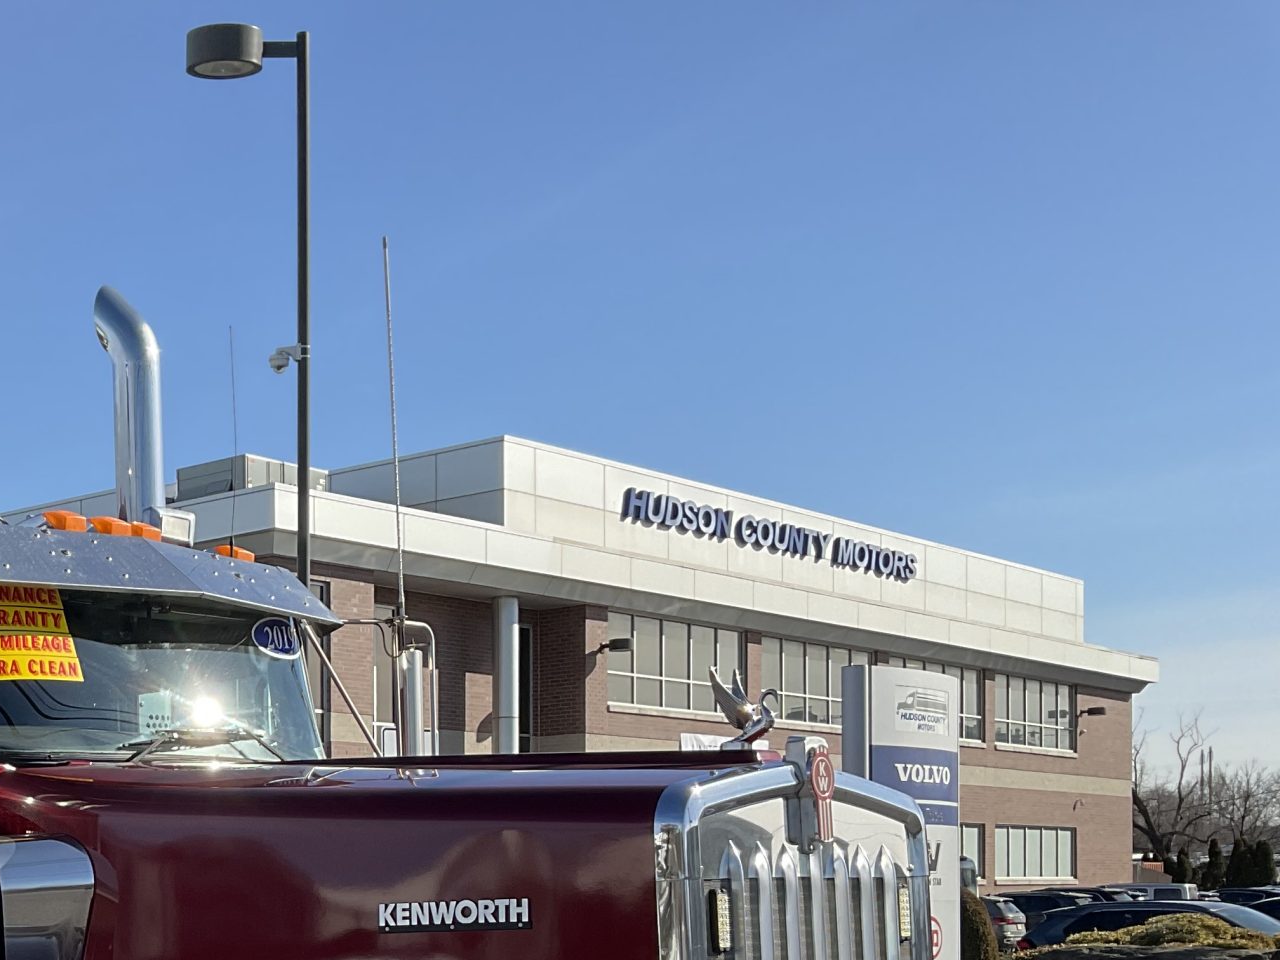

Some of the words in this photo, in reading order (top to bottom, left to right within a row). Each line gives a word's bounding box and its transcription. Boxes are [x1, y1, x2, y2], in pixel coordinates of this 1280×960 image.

[622, 487, 733, 543] HUDSON
[736, 515, 833, 563] COUNTY
[832, 536, 918, 583] MOTORS
[0, 635, 72, 653] MILEAGE
[28, 659, 78, 677] CLEAN
[901, 712, 926, 721] HUDSON
[927, 715, 945, 724] COUNTY
[917, 723, 935, 732] MOTORS
[894, 763, 951, 785] VOLVO
[378, 898, 529, 927] KENWORTH
